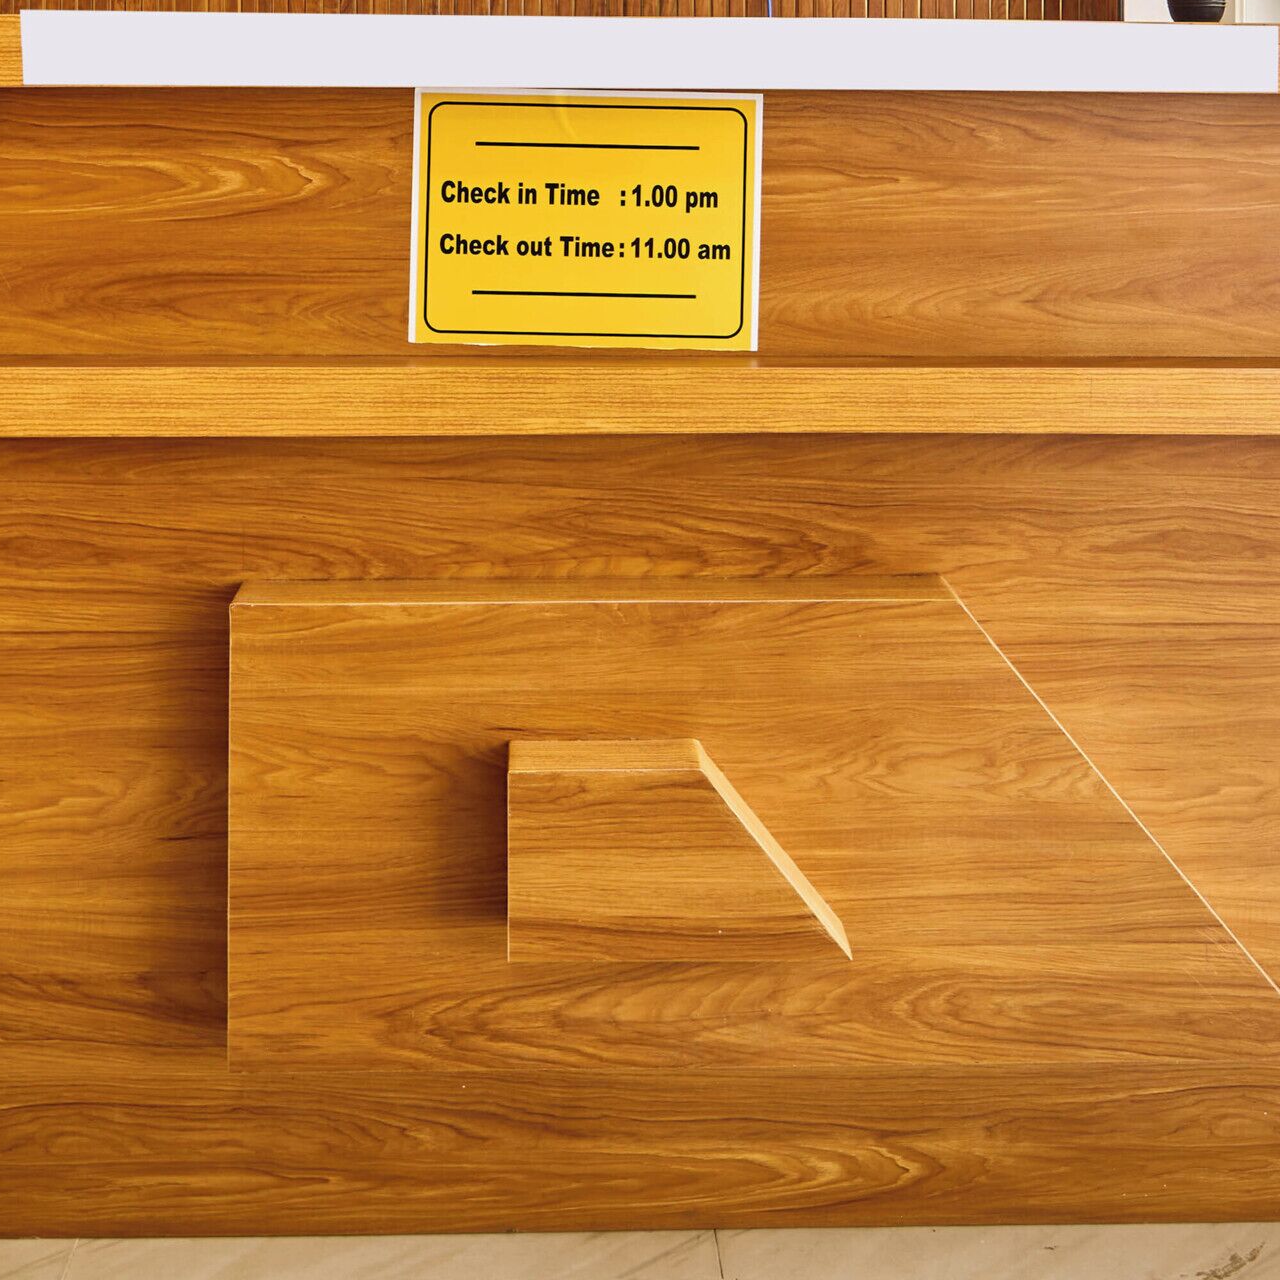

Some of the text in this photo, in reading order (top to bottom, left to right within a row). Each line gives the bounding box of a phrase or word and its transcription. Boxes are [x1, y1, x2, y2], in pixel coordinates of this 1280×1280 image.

[441, 179, 511, 204] Check
[518, 182, 537, 205] in
[545, 182, 600, 206] Time
[686, 191, 719, 214] pm
[439, 233, 510, 256] Check
[516, 236, 553, 257] out
[697, 243, 731, 260] am
